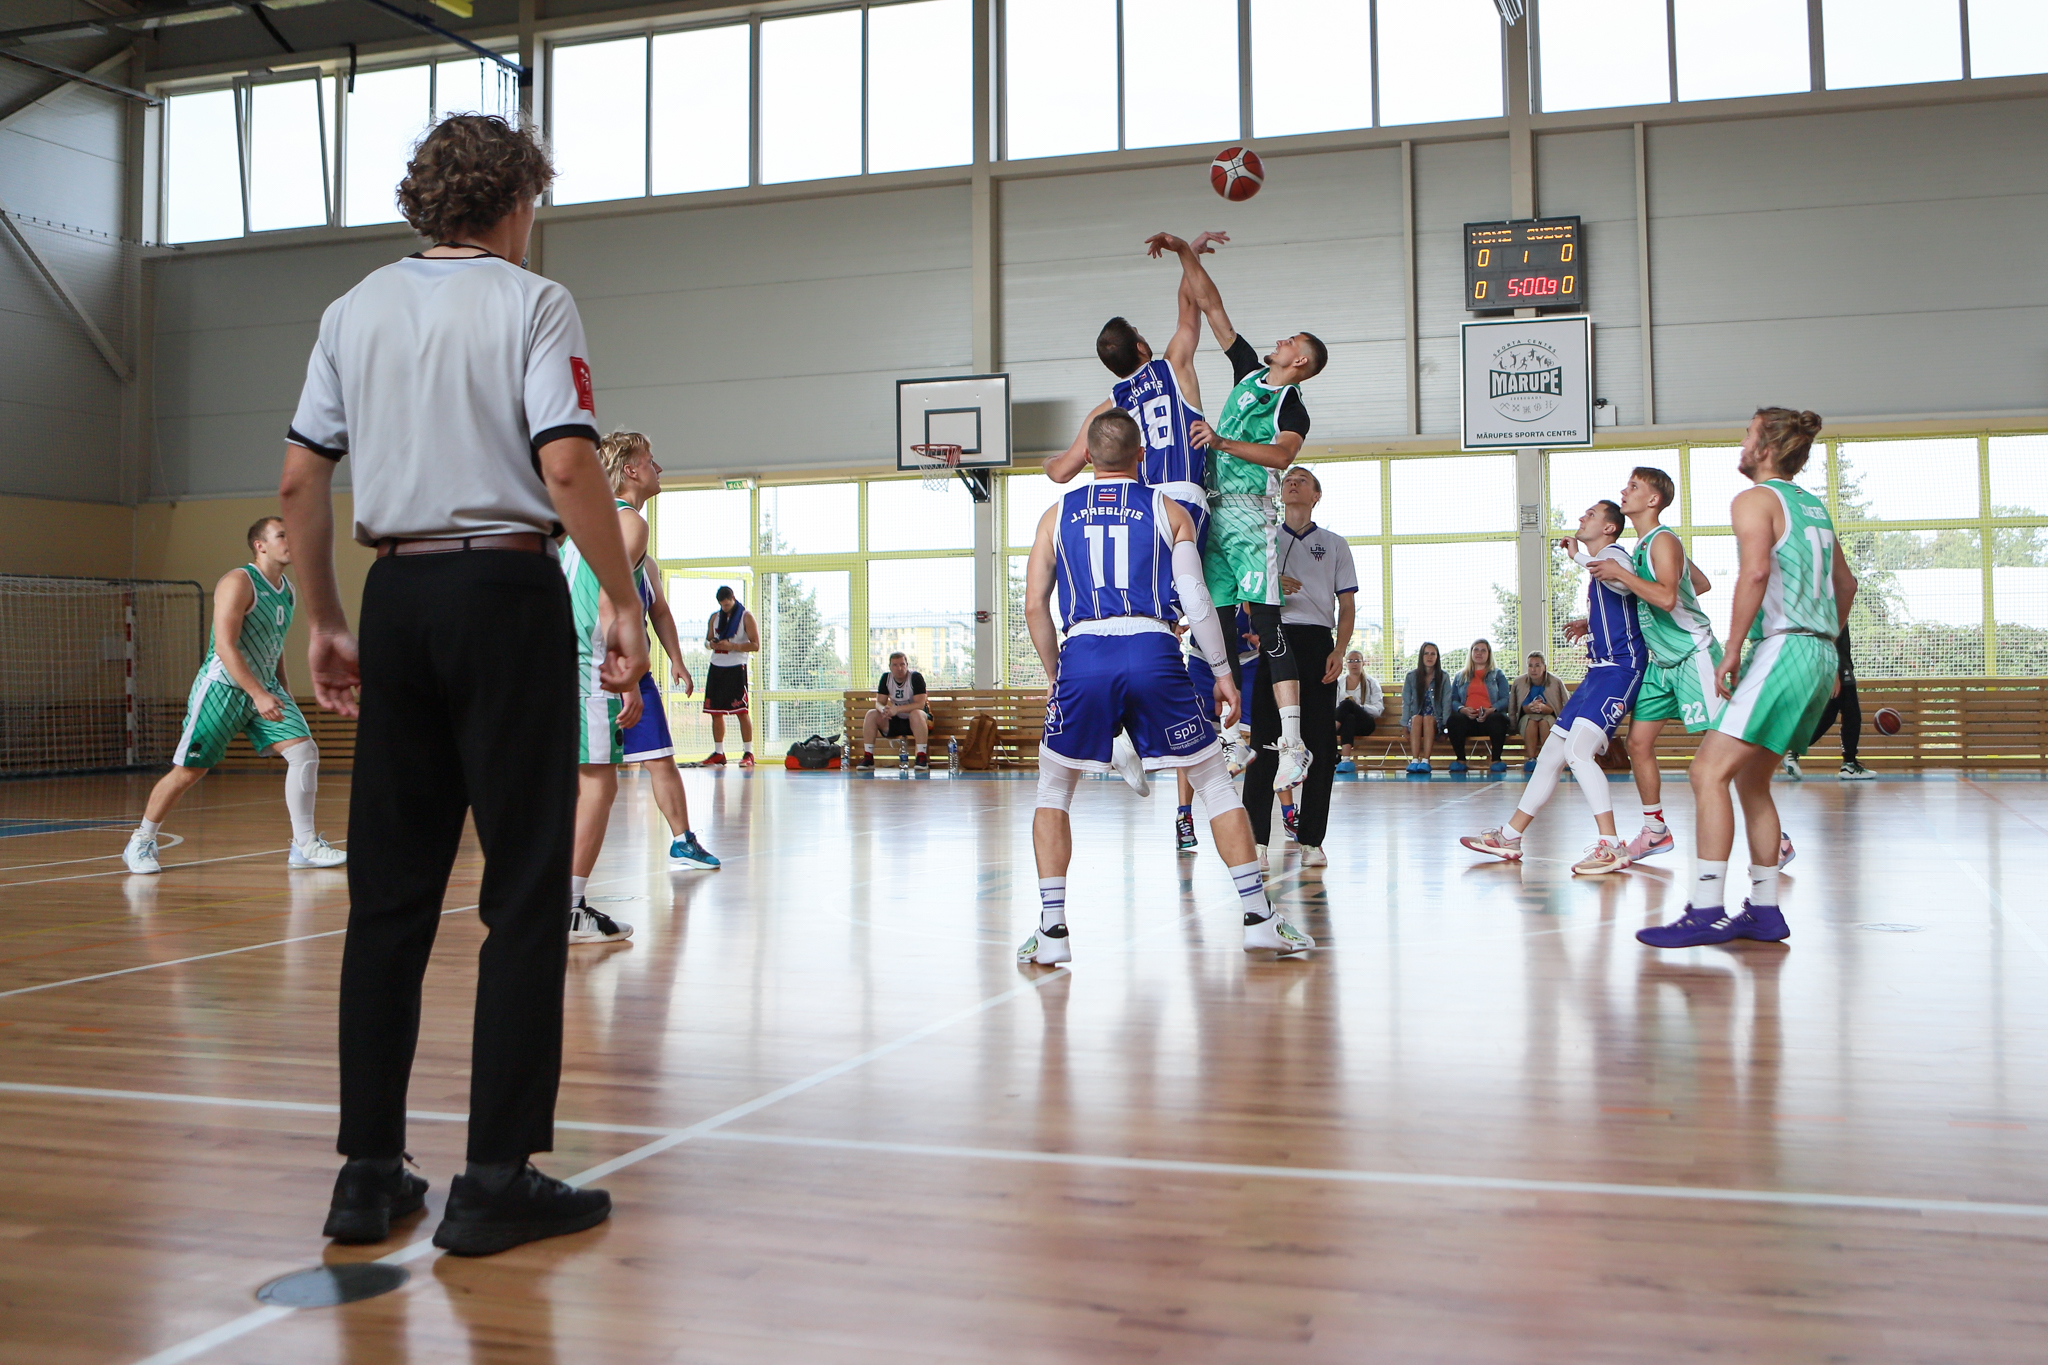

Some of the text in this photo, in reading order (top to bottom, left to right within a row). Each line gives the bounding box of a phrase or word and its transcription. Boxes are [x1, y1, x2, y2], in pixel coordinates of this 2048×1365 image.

[1477, 243, 1574, 267] 0 1 0
[1474, 280, 1487, 299] 0
[1561, 275, 1574, 294] 0
[1492, 338, 1557, 357] SPORTA CENTRS
[1491, 369, 1560, 397] MĀRUPE
[1476, 429, 1577, 440] MĀRUPES SPORTA CENTRS
[1083, 524, 1129, 590] 11
[1803, 525, 1834, 600] 17
[1240, 571, 1264, 594] 47
[276, 605, 285, 626] 0
[1681, 700, 1707, 726] 22
[1174, 723, 1197, 740] spb
